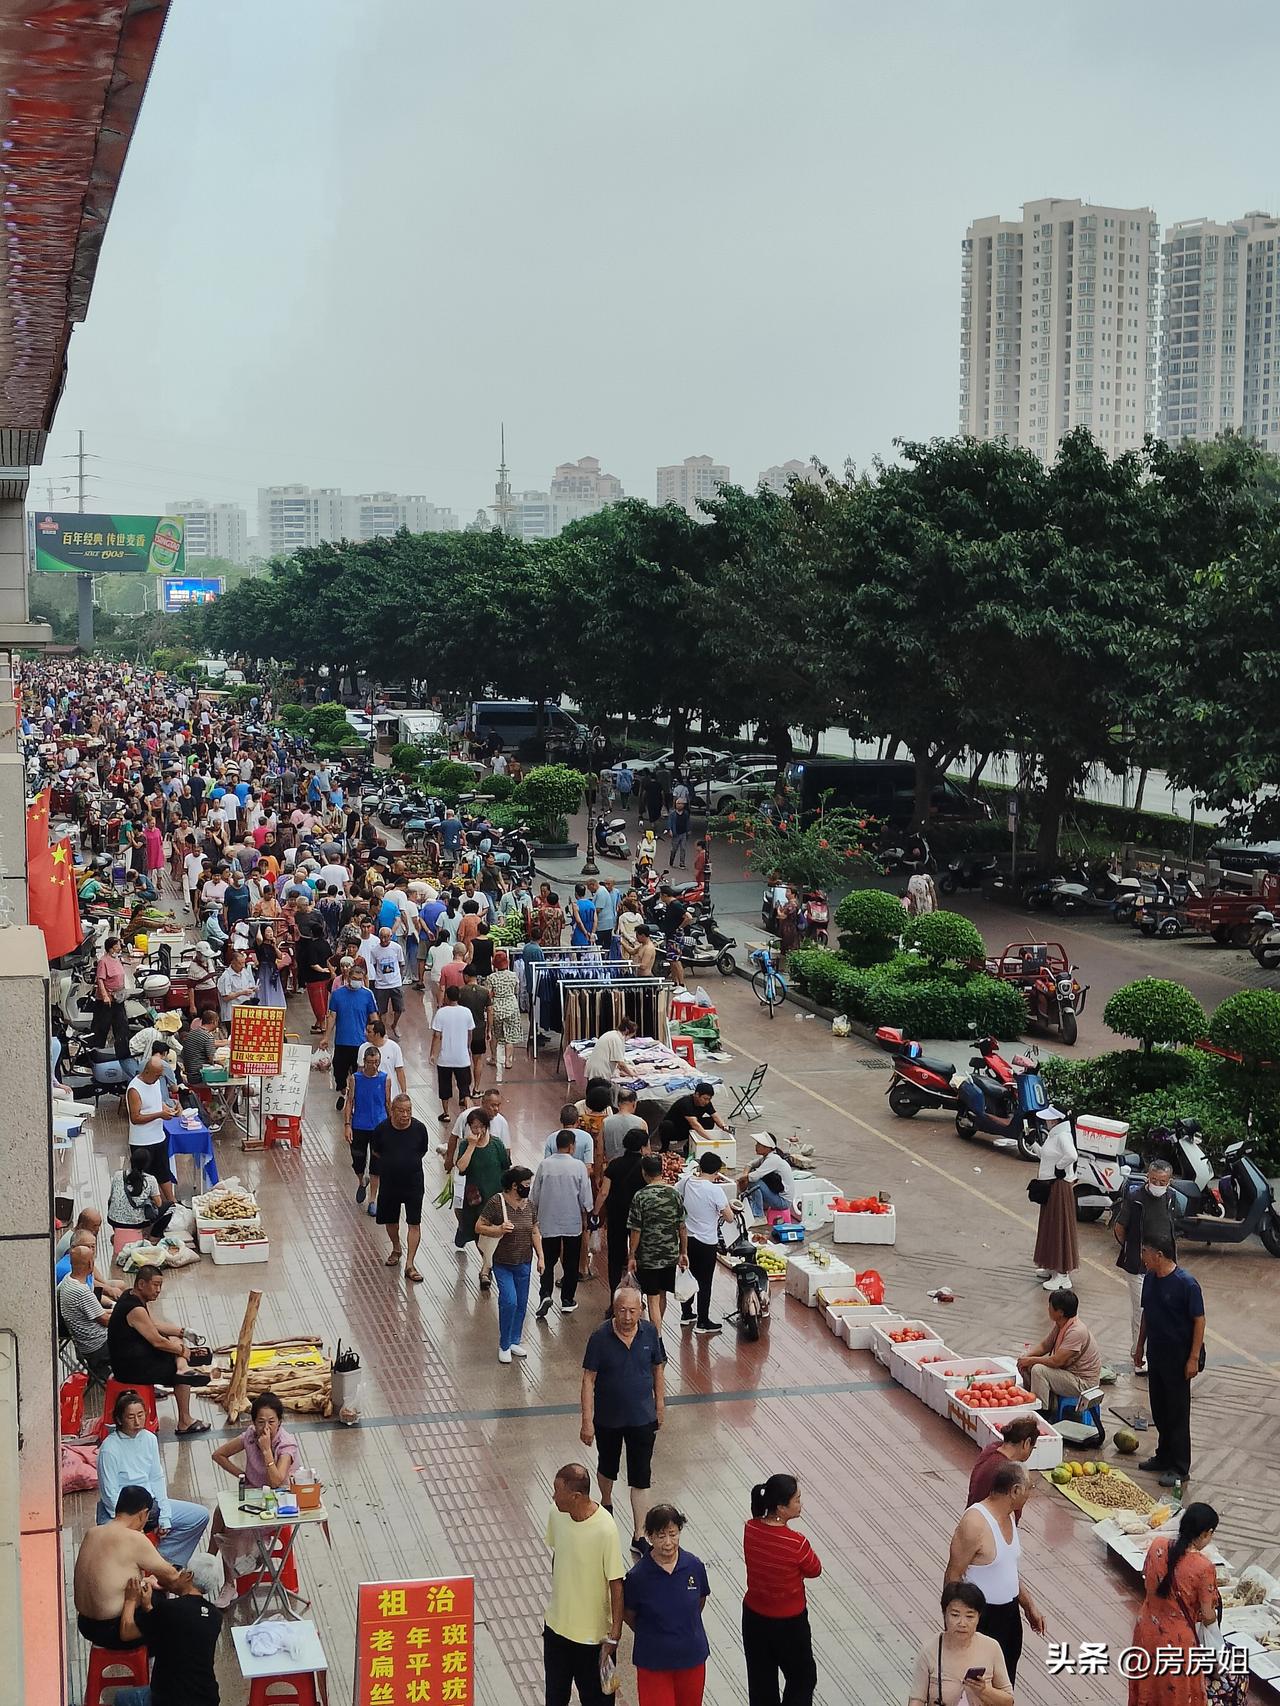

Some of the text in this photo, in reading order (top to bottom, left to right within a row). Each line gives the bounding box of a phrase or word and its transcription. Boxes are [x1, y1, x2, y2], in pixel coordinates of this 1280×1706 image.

[62, 532, 146, 547] 百年经典 传世麦香
[235, 1052, 275, 1061] 招收学员
[264, 1097, 300, 1112] 3元一个
[378, 1585, 455, 1616] 祖治
[369, 1624, 468, 1652] 老年斑
[369, 1650, 468, 1678] 扁平疣
[369, 1677, 468, 1706] 丝状疣
